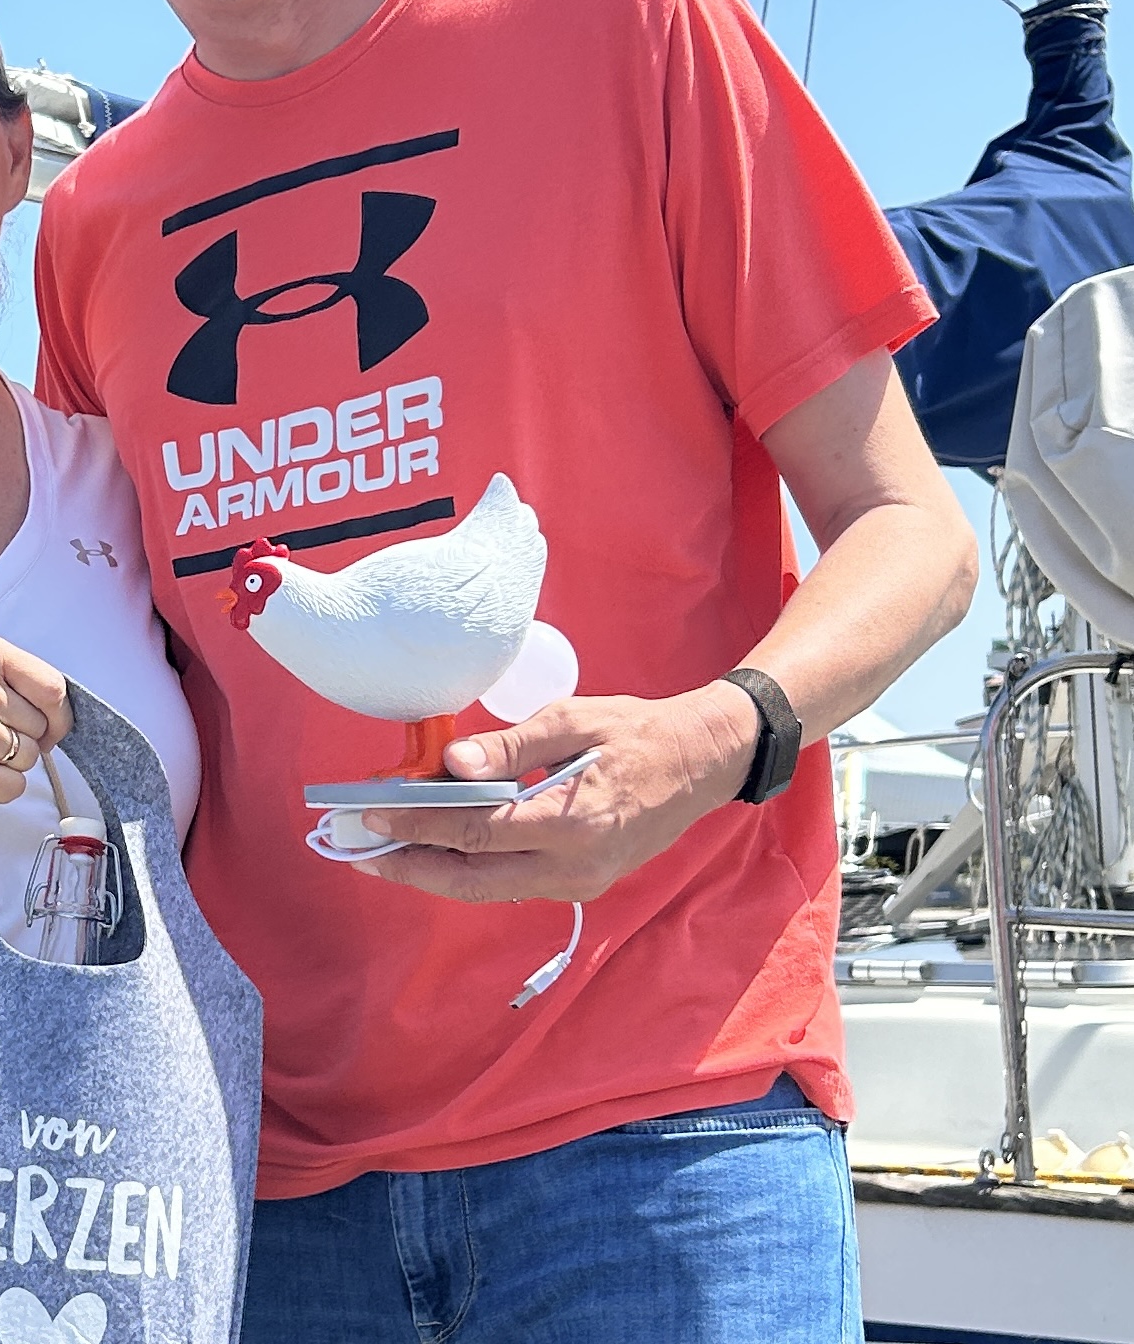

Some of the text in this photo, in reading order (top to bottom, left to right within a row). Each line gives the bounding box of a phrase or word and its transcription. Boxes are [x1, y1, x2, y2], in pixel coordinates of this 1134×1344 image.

[161, 375, 443, 492] UNDER
[175, 436, 440, 536] ARMOUR
[20, 1109, 117, 1156] von
